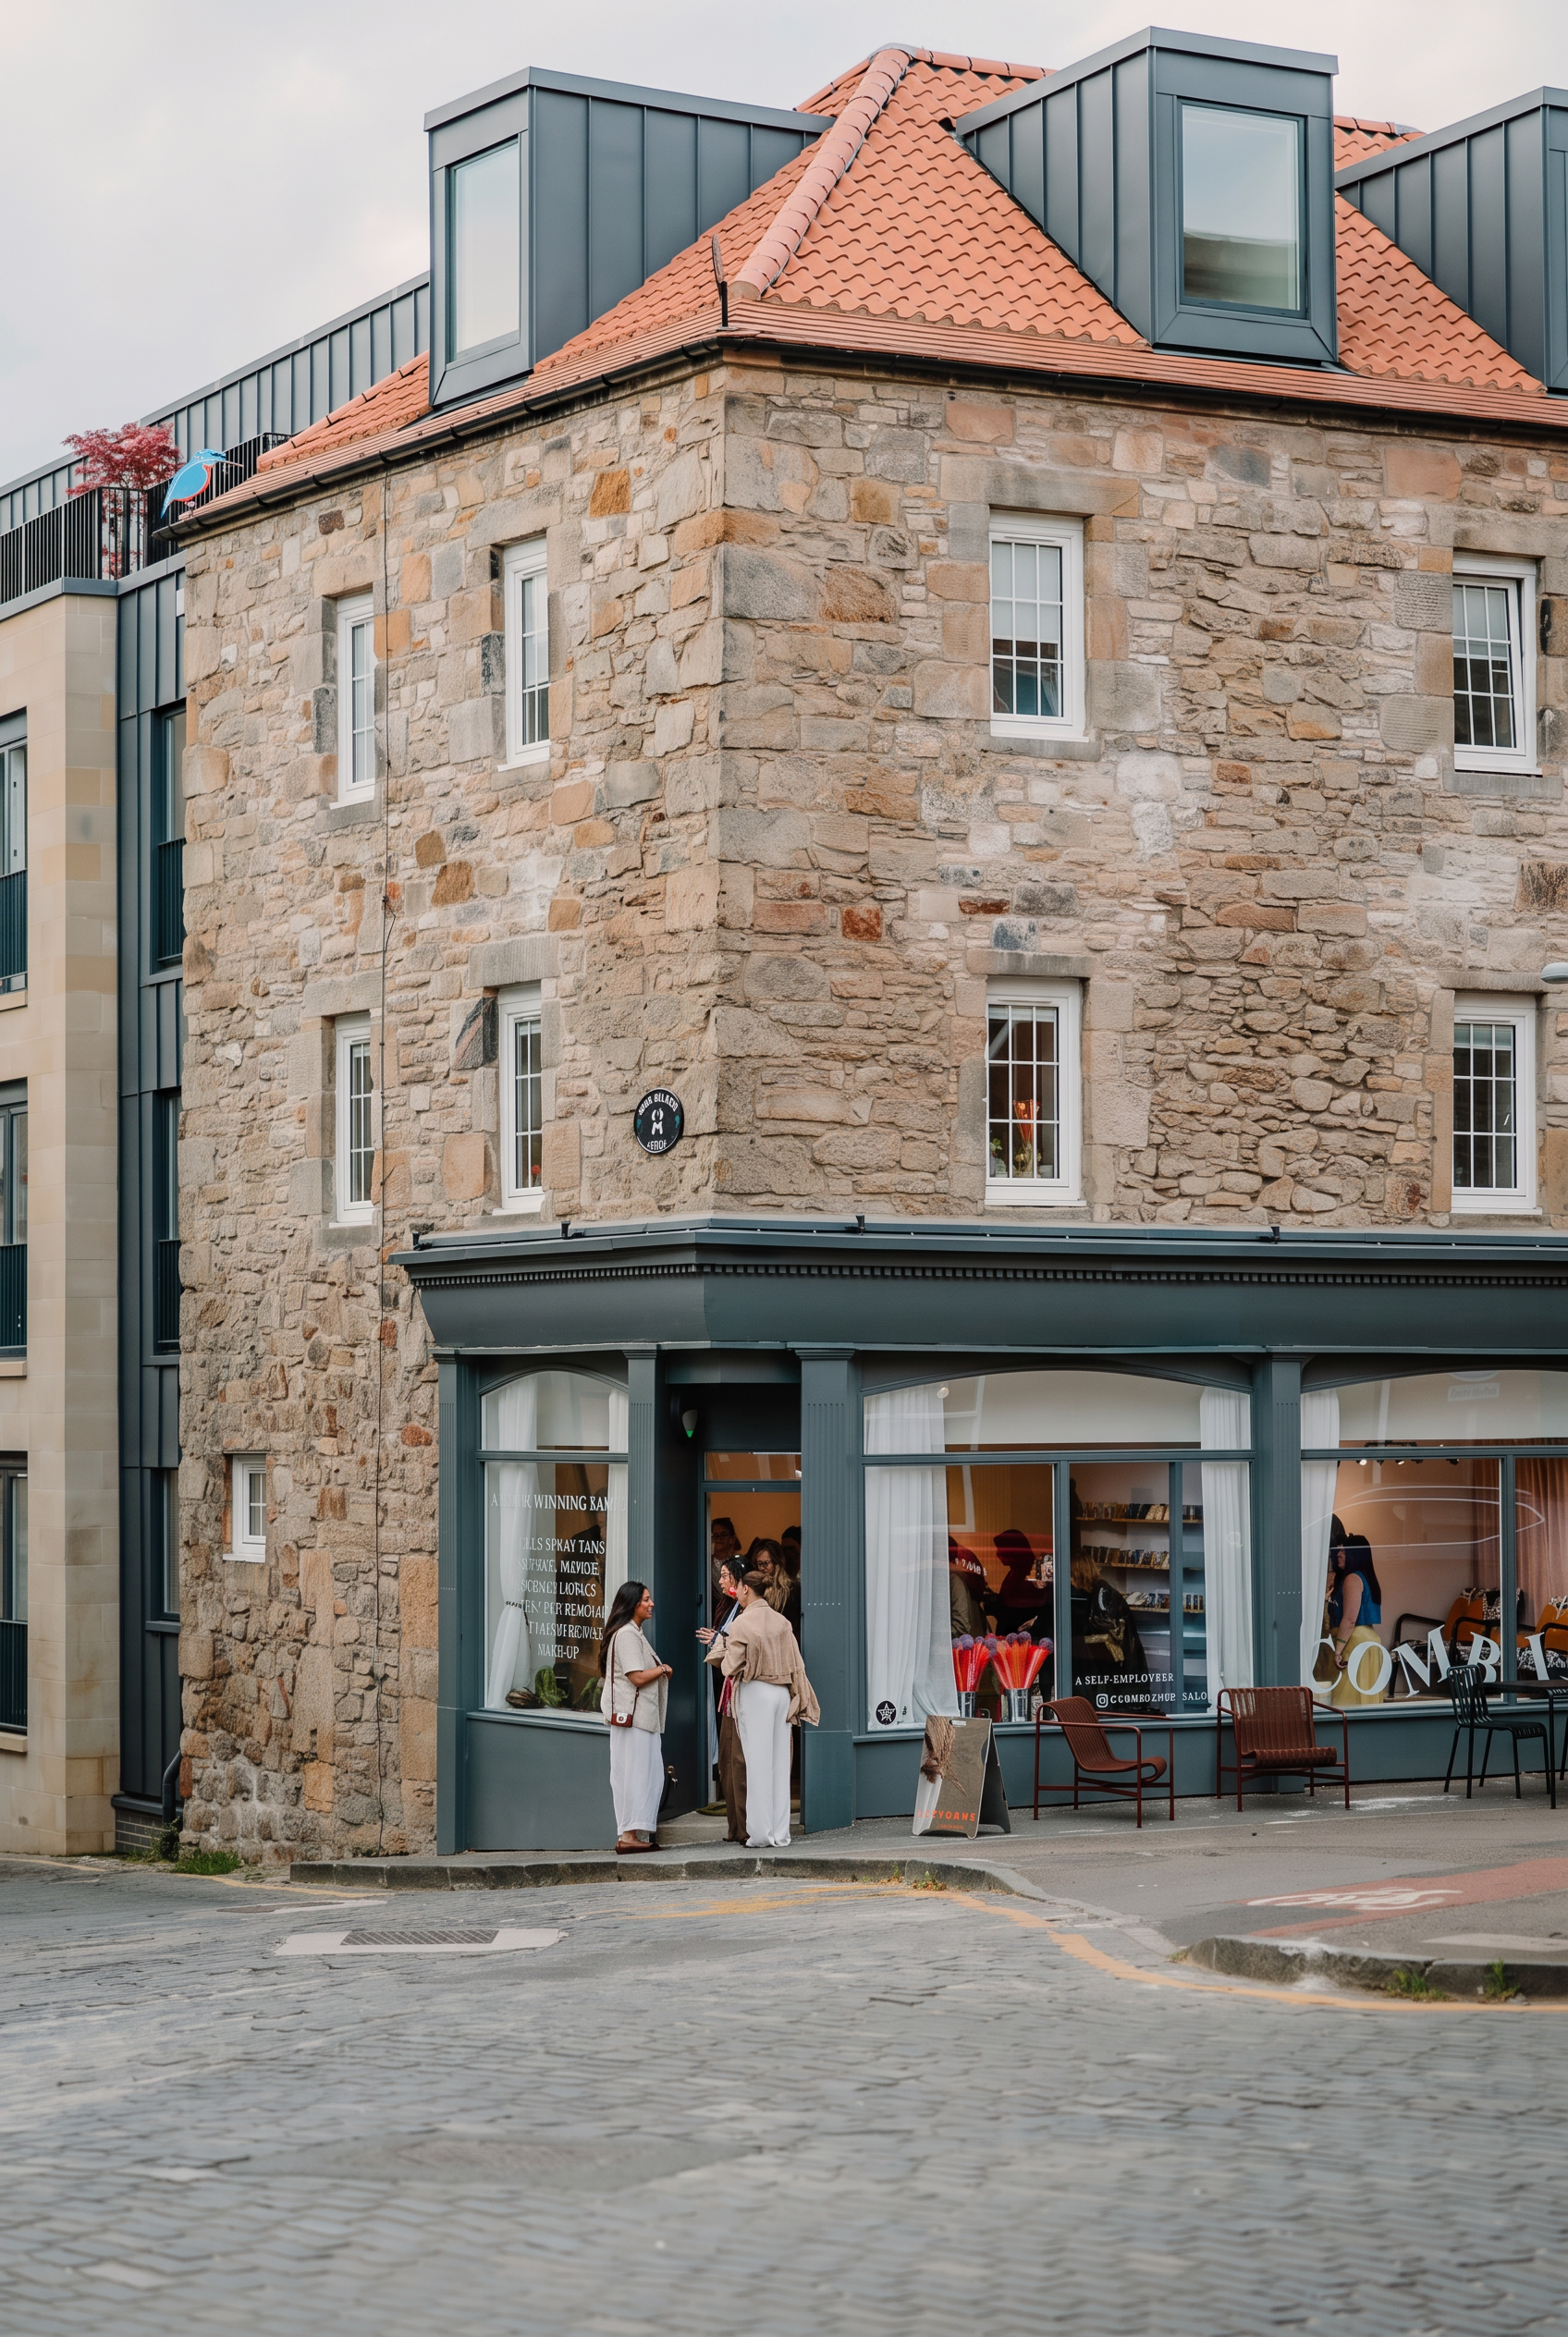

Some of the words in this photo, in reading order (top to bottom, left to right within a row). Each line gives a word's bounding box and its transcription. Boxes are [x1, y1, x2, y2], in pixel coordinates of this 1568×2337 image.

[534, 1494, 587, 1511] WINNING
[579, 1539, 606, 1555] TANS
[1075, 1676, 1083, 1685] A
